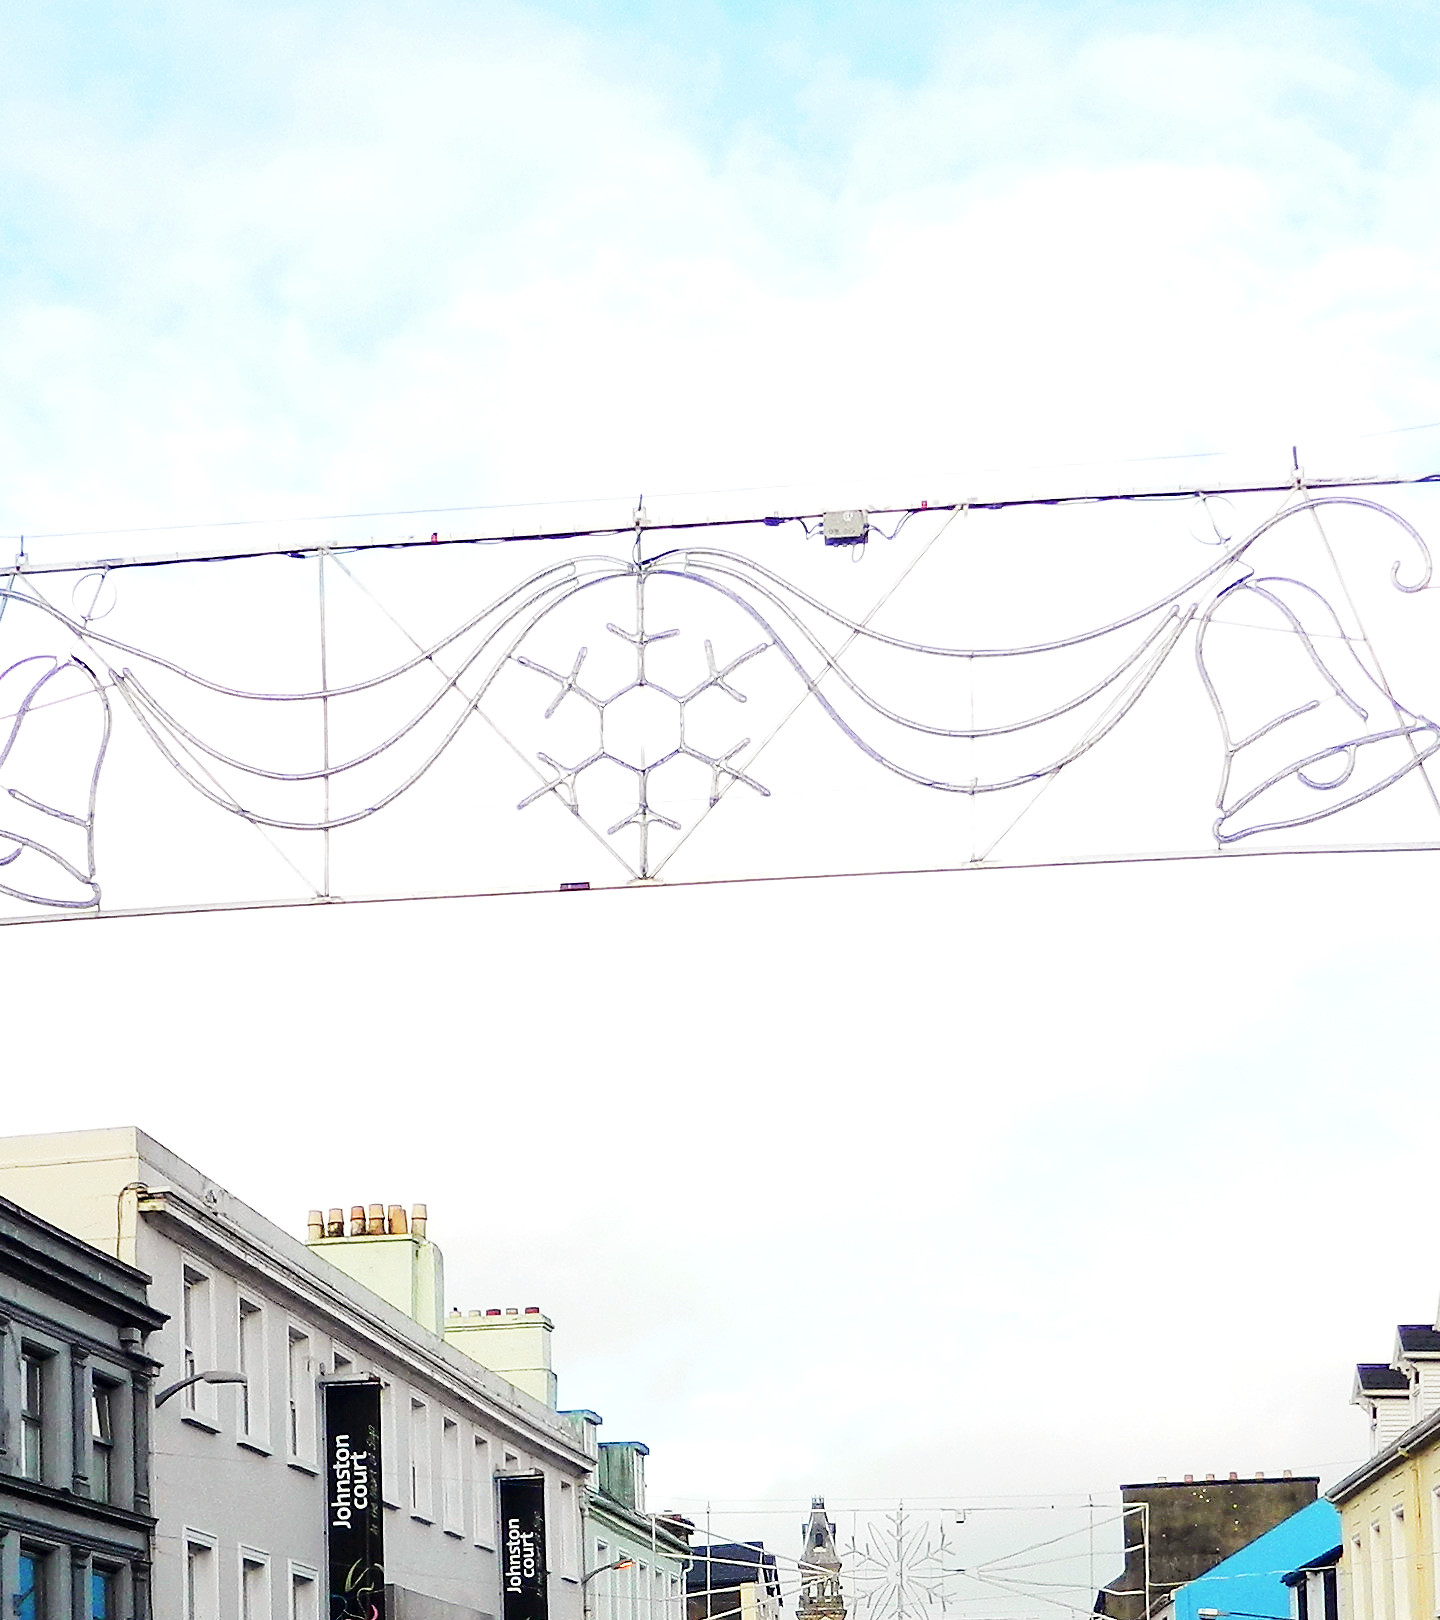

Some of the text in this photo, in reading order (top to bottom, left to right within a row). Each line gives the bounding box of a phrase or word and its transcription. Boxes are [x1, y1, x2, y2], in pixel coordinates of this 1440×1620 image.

[331, 1433, 351, 1529] Johnston
[350, 1450, 368, 1511] court
[506, 1518, 522, 1594] Johnston
[520, 1531, 534, 1578] court
